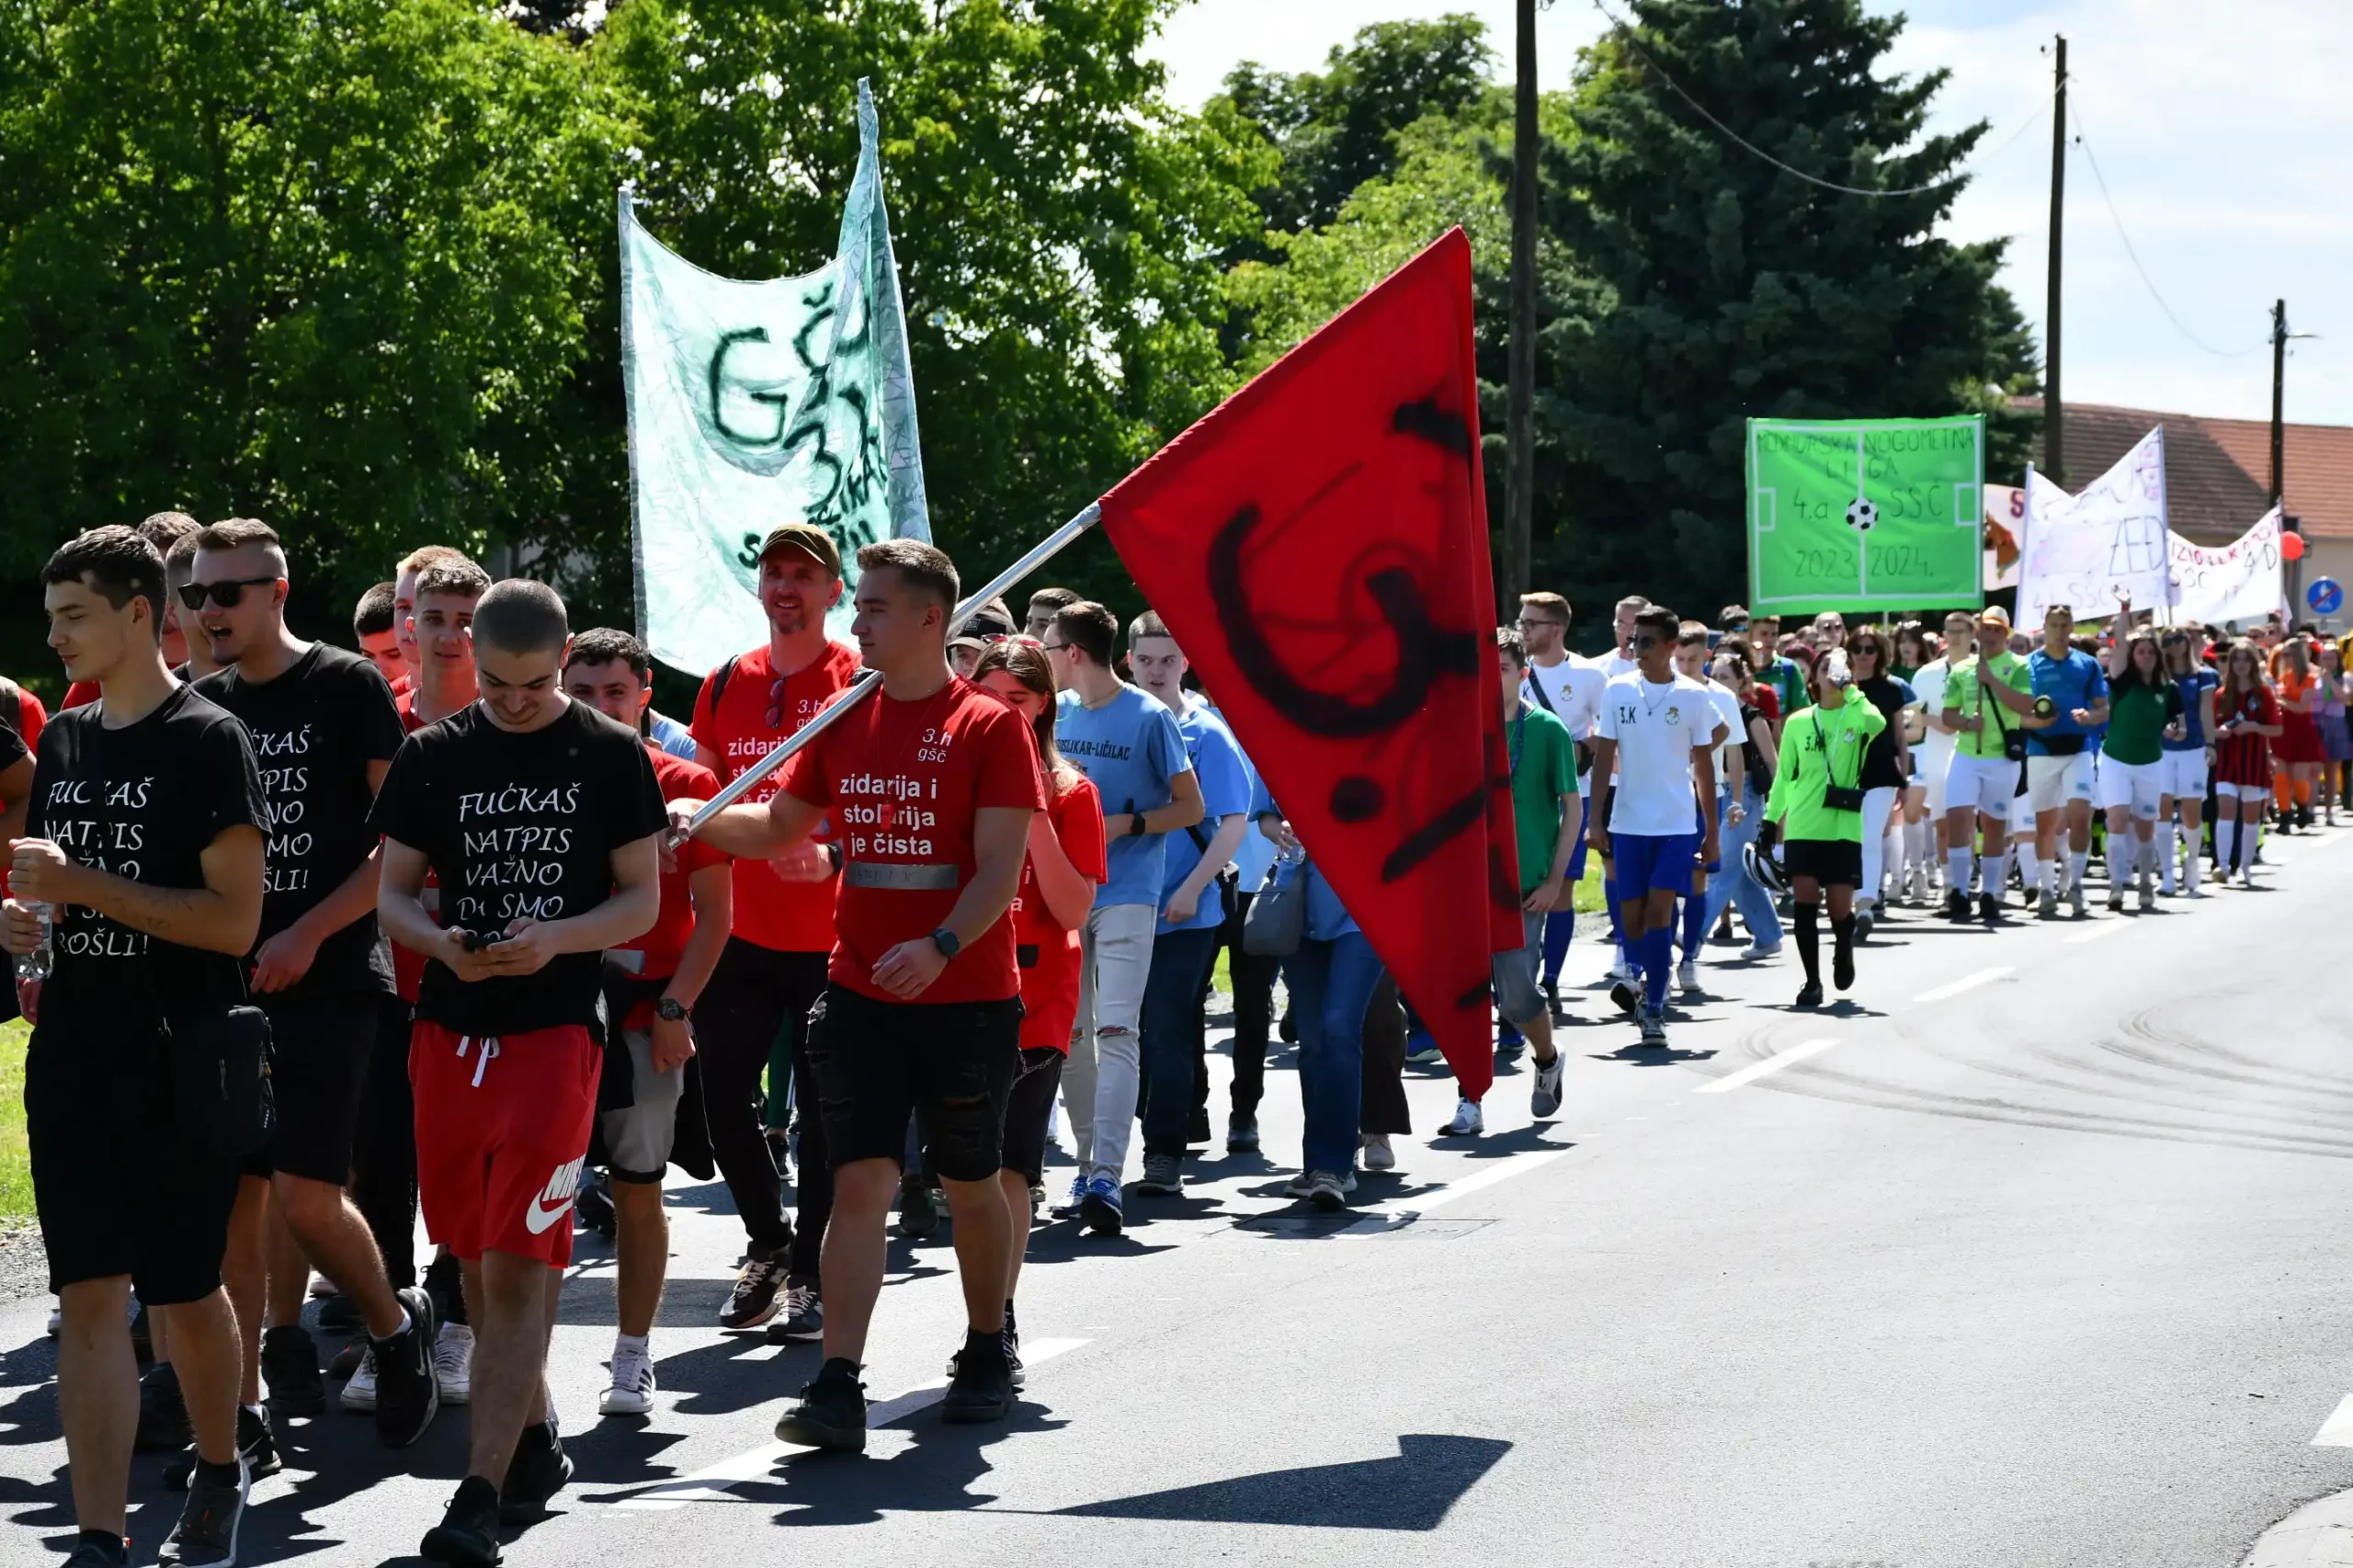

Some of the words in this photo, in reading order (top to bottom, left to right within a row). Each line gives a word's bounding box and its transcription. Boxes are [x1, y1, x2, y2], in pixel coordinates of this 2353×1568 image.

[1620, 706, 1636, 724] 3.K
[922, 728, 952, 746] 3.h
[917, 747, 947, 763] gšč
[839, 773, 920, 801] zidarija
[930, 778, 938, 800] i
[267, 833, 313, 857] MO
[464, 825, 574, 857] NATPIS
[851, 832, 867, 857] je
[873, 833, 933, 856] čista
[465, 854, 563, 887] VAŽNO
[497, 892, 563, 919] SMO
